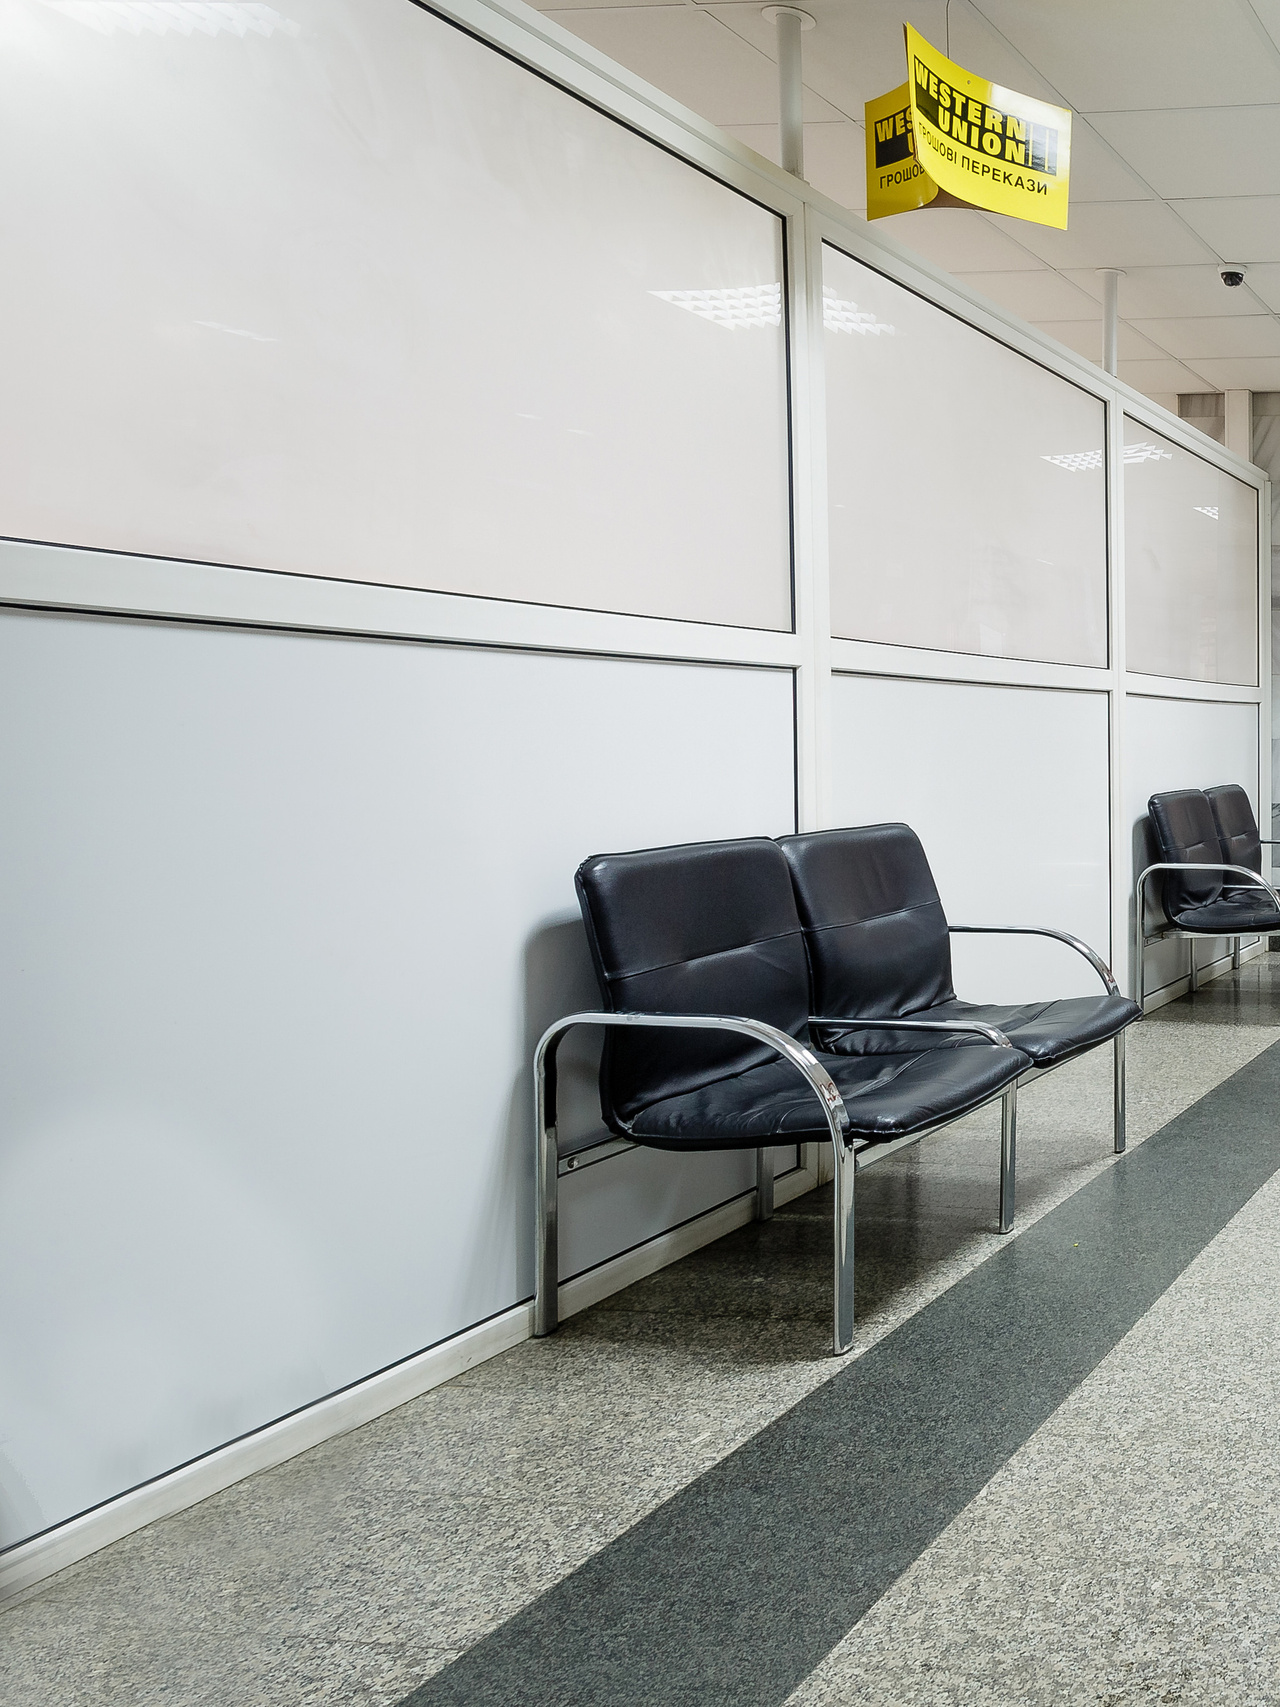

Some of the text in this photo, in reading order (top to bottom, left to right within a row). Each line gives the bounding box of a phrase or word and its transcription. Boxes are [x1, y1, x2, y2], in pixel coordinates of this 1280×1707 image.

[914, 58, 1027, 142] WESTERN
[938, 105, 1026, 165] UNION
[919, 121, 957, 164] ГРОШОВІ
[961, 155, 1048, 196] ПЕРЕКАЗИ
